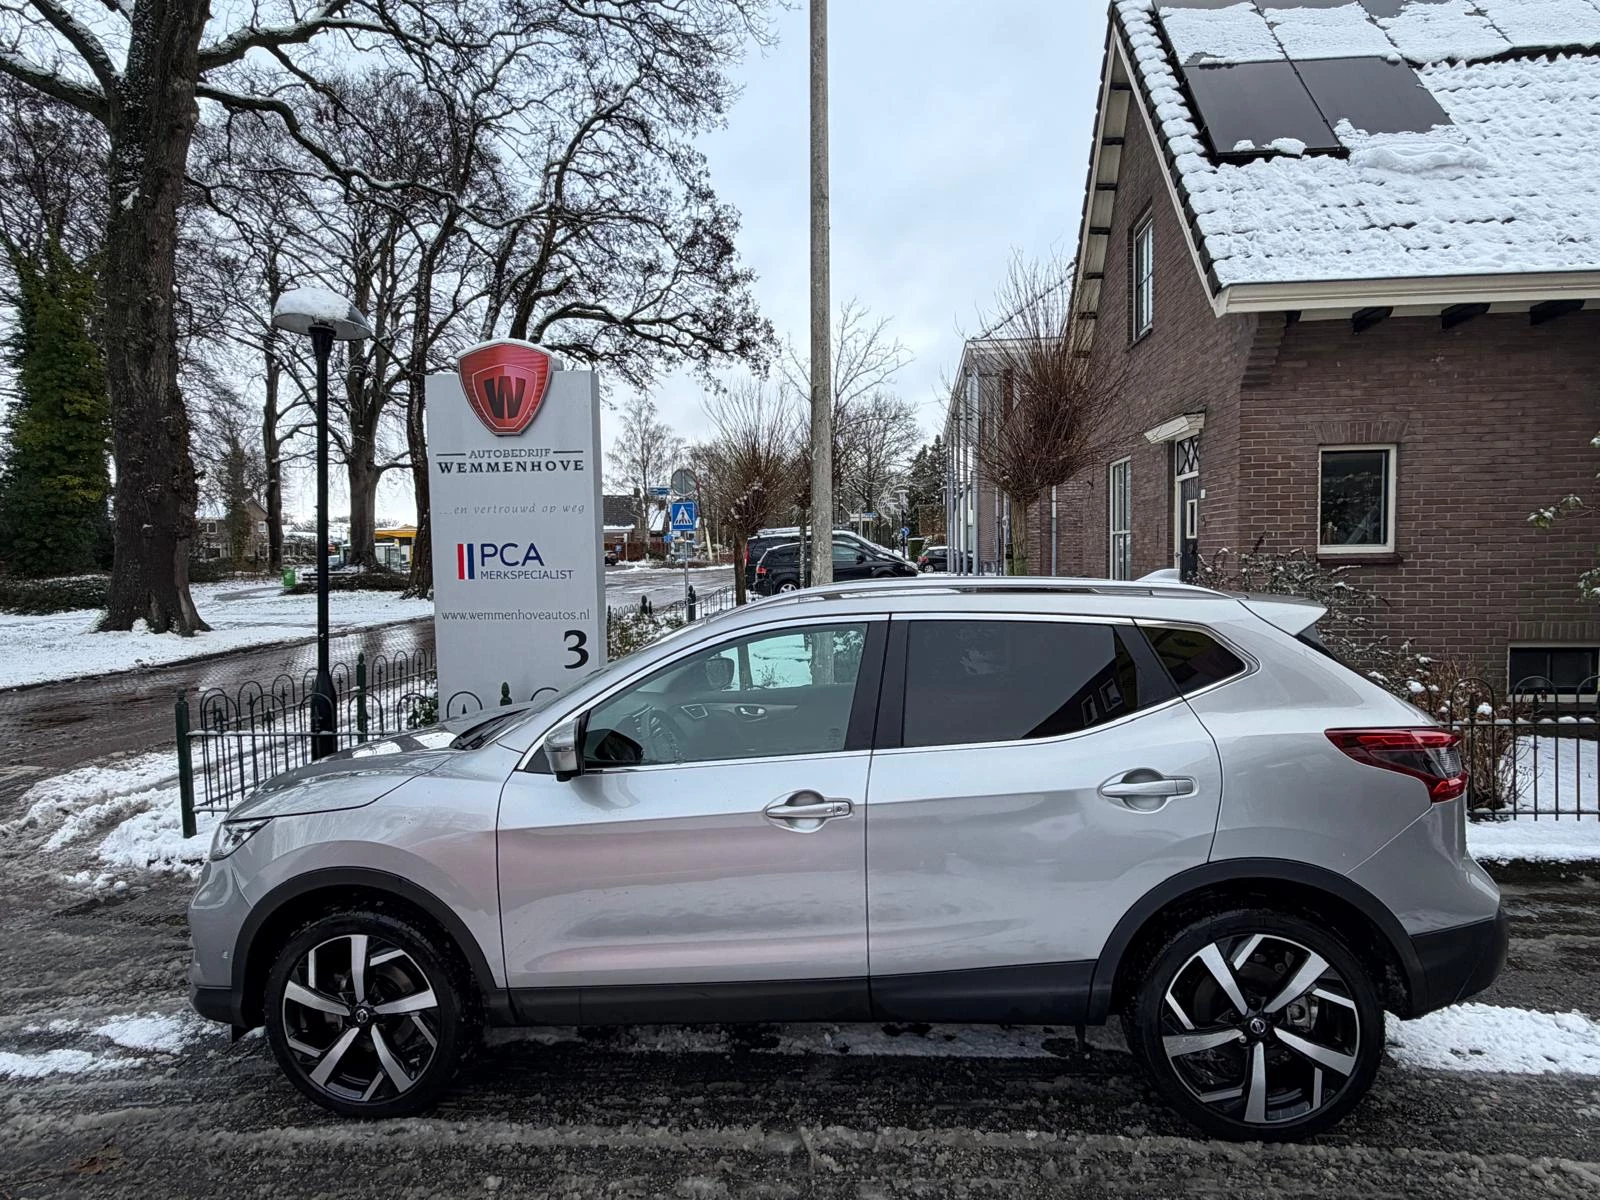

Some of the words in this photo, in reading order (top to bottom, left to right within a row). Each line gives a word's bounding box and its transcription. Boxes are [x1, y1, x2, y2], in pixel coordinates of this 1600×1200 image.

[468, 448, 551, 459] AUTOBEDRIJF
[437, 460, 584, 474] WEMMENHOVE
[474, 503, 536, 514] vertrouwd
[541, 504, 556, 514] op
[562, 503, 585, 514] weg
[480, 543, 545, 567] PCA
[480, 570, 574, 580] MERKSPECIALIST
[441, 608, 590, 621] www.wemmenhoveautos.nl
[563, 629, 589, 669] 3
